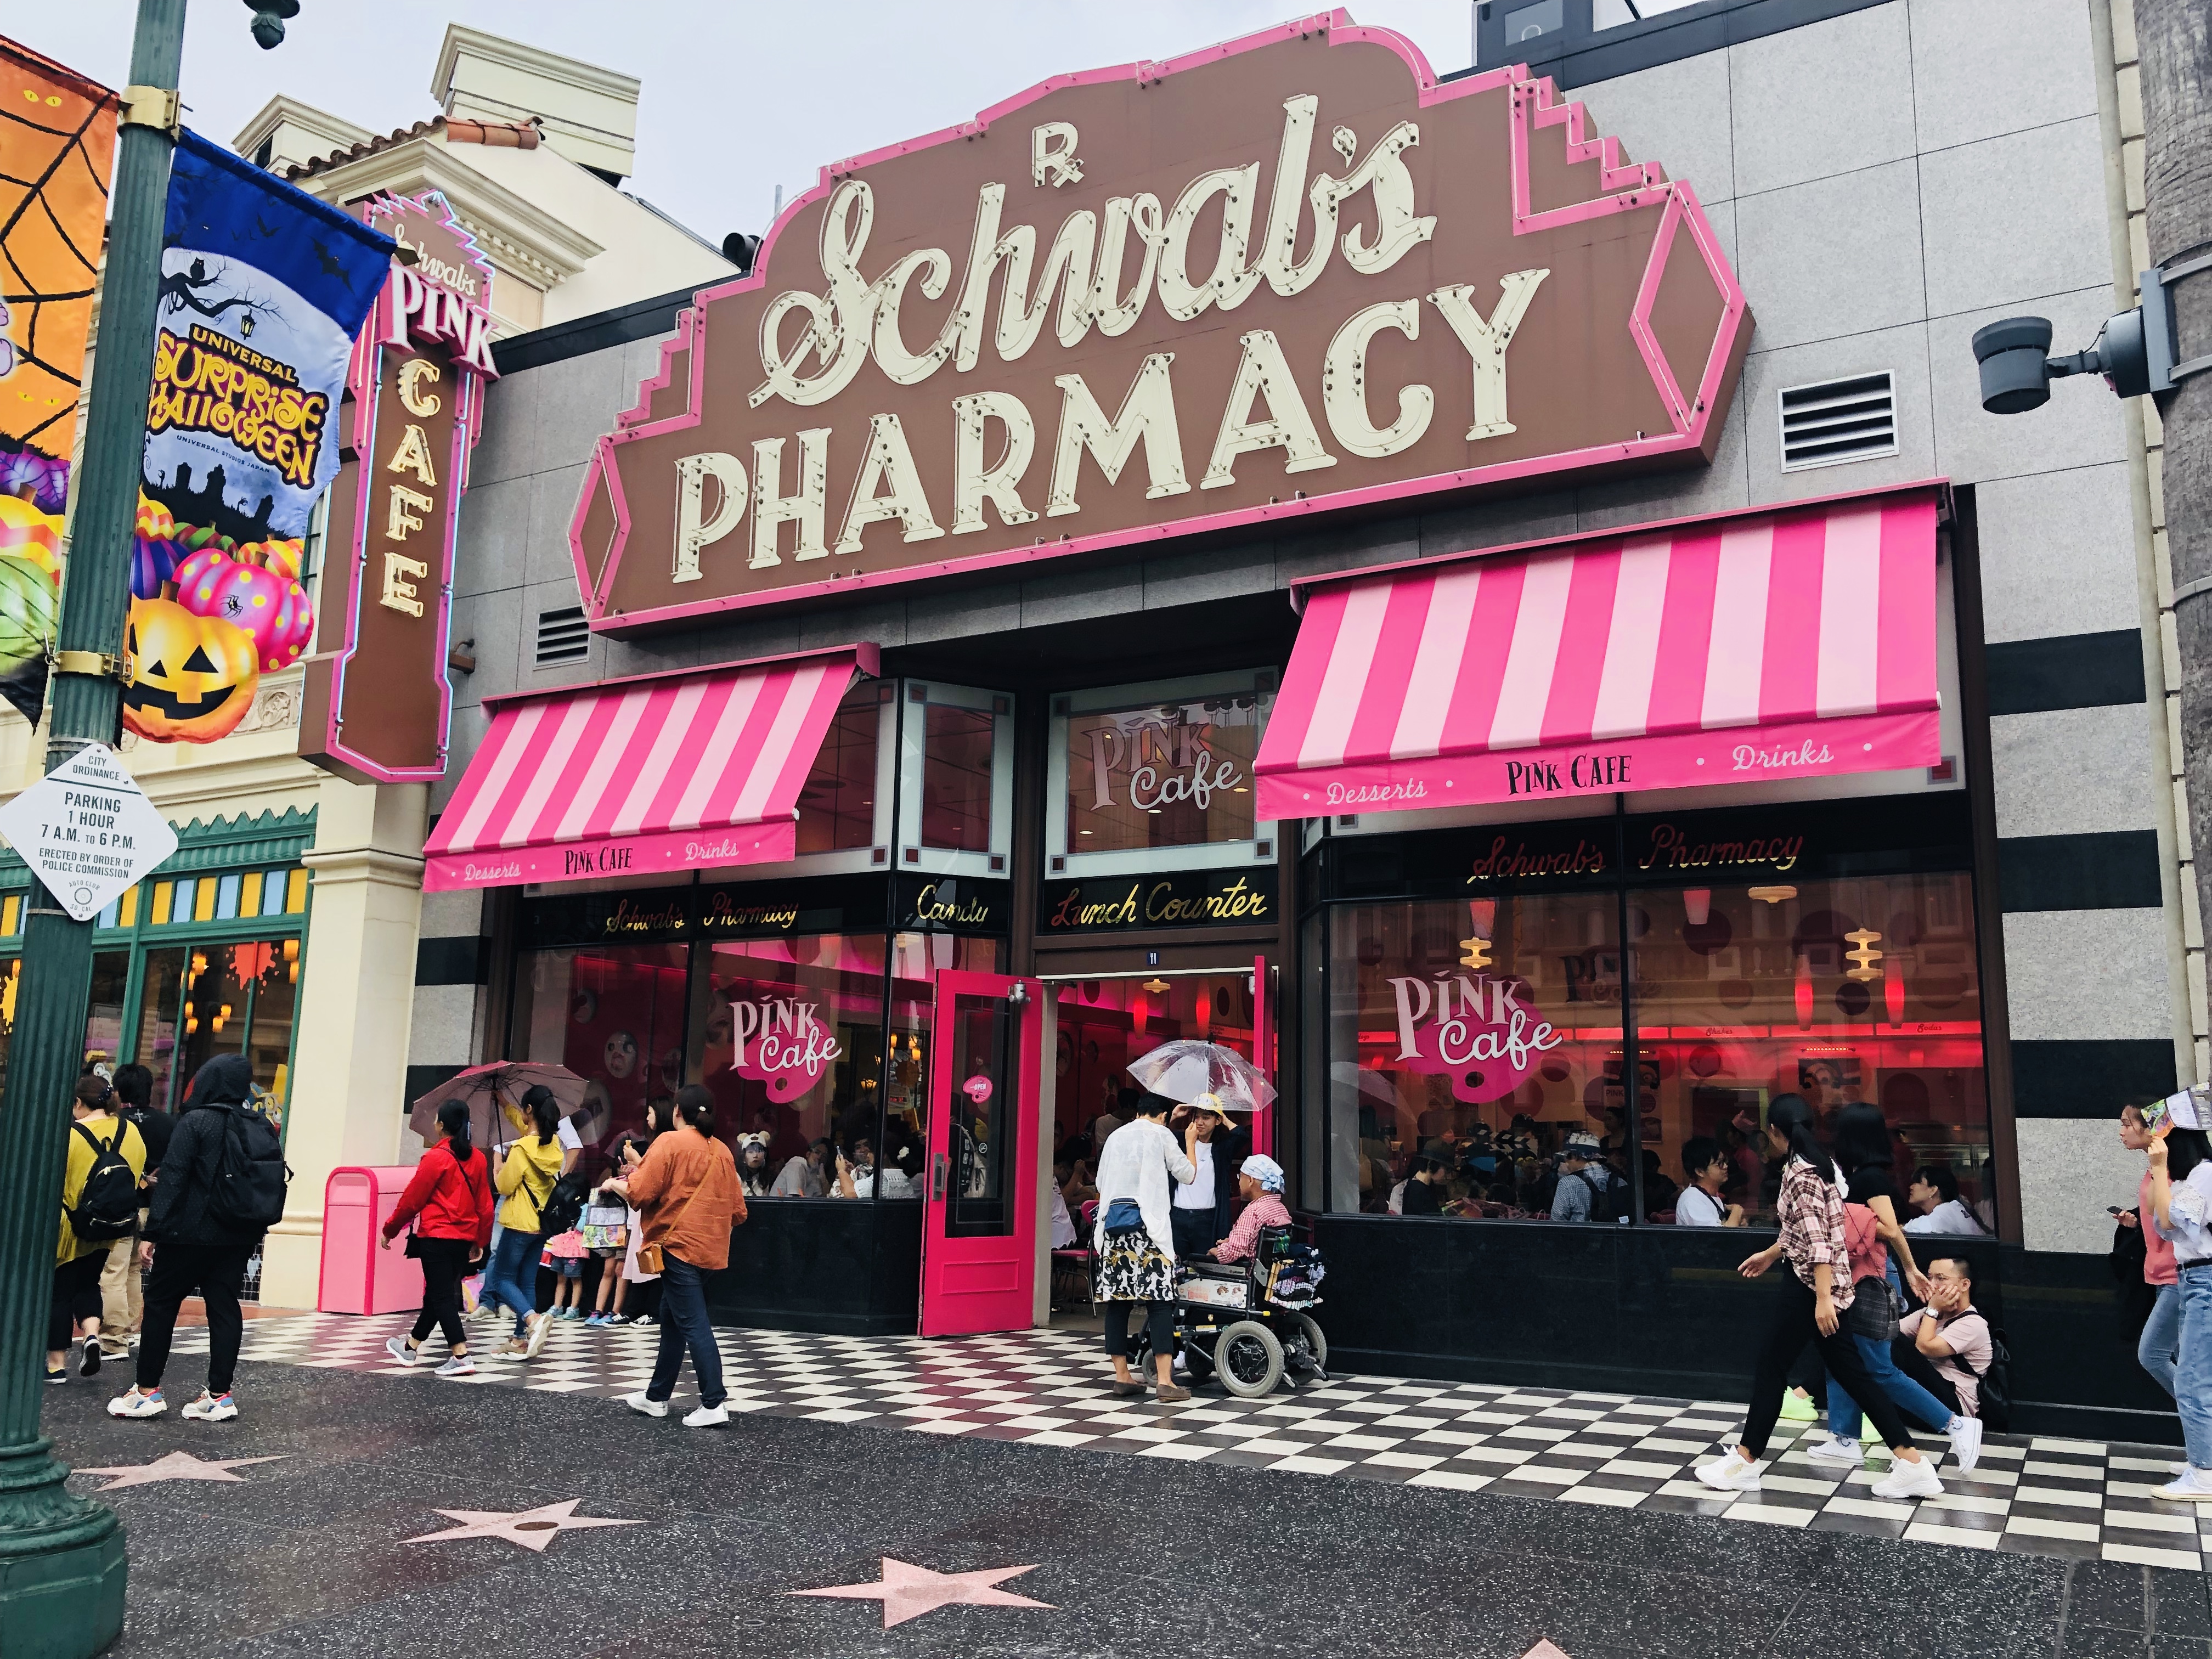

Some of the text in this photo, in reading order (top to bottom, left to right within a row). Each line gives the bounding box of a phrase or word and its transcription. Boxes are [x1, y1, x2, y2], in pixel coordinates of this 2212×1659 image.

[747, 93, 1437, 408] Schwab's
[386, 263, 500, 380] PINK
[192, 325, 296, 383] UNIVERSAL
[672, 268, 1550, 584] PHARMACY
[177, 435, 270, 473] UNIVERSAL STUDIOS JAPAN
[380, 358, 441, 618] CAFE
[72, 764, 120, 781] ORDINANCE
[88, 755, 107, 766] CITY
[1129, 751, 1243, 810] Cafe
[1325, 738, 1835, 806] Desserts PINK CAFE Drinks
[65, 792, 121, 813] PARKING
[69, 810, 114, 829] 1 HOUR
[39, 848, 133, 868] ERECTED BY ORDER OF
[42, 824, 136, 850] 7 A.M. TO 6 P.M.
[1465, 824, 1806, 885] Schwab's Pharmacy
[42, 860, 129, 879] POLICE COMMISSION
[85, 880, 100, 890] CLUB
[463, 842, 740, 883] Desserts PINK CAFE Drinks
[602, 891, 800, 935] Schwab's Pharmacy
[917, 884, 989, 929] Candy
[1051, 876, 1267, 927] Lunch Counter
[729, 995, 843, 1077] PINK Cafe
[1385, 969, 1533, 1062] PINK
[1438, 1009, 1564, 1071] Cafe
[1605, 1089, 1624, 1097] PINK
